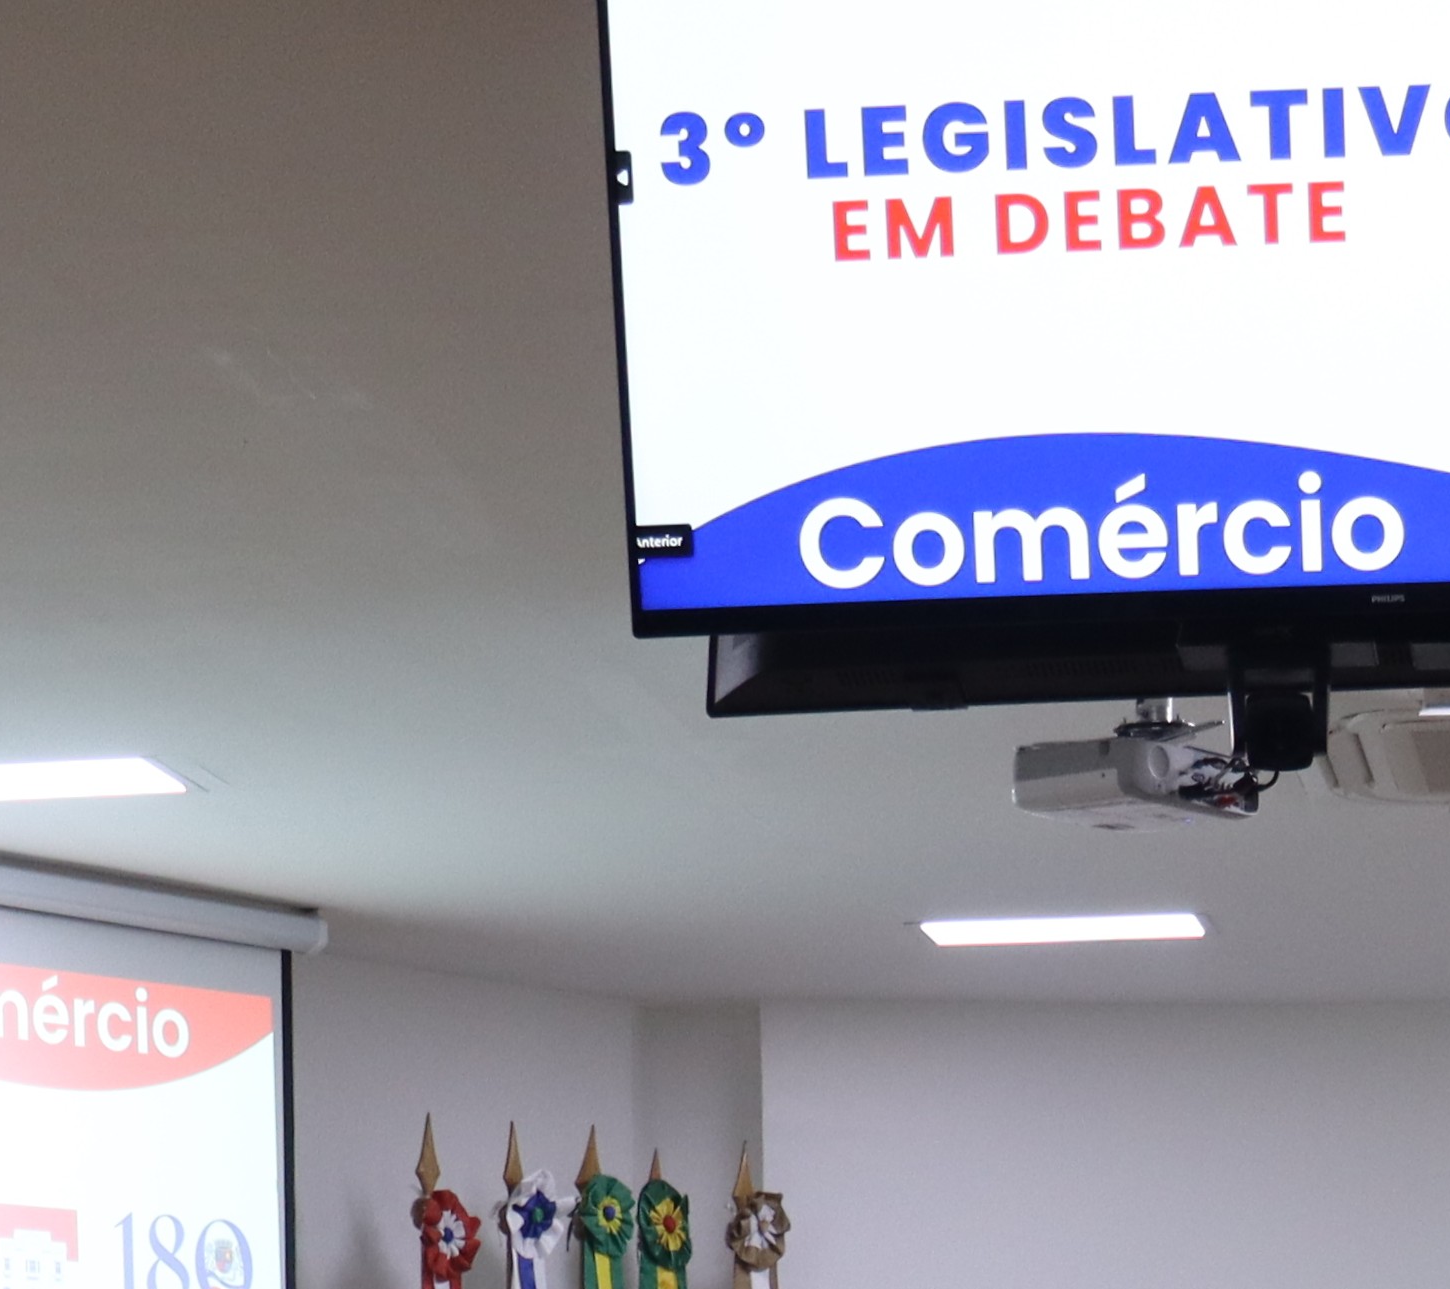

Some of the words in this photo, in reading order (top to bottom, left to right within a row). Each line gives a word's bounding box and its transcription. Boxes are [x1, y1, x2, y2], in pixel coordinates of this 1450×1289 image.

[831, 197, 955, 262] EM
[994, 180, 1347, 257] DEBATE
[799, 470, 1405, 590] Comércio
